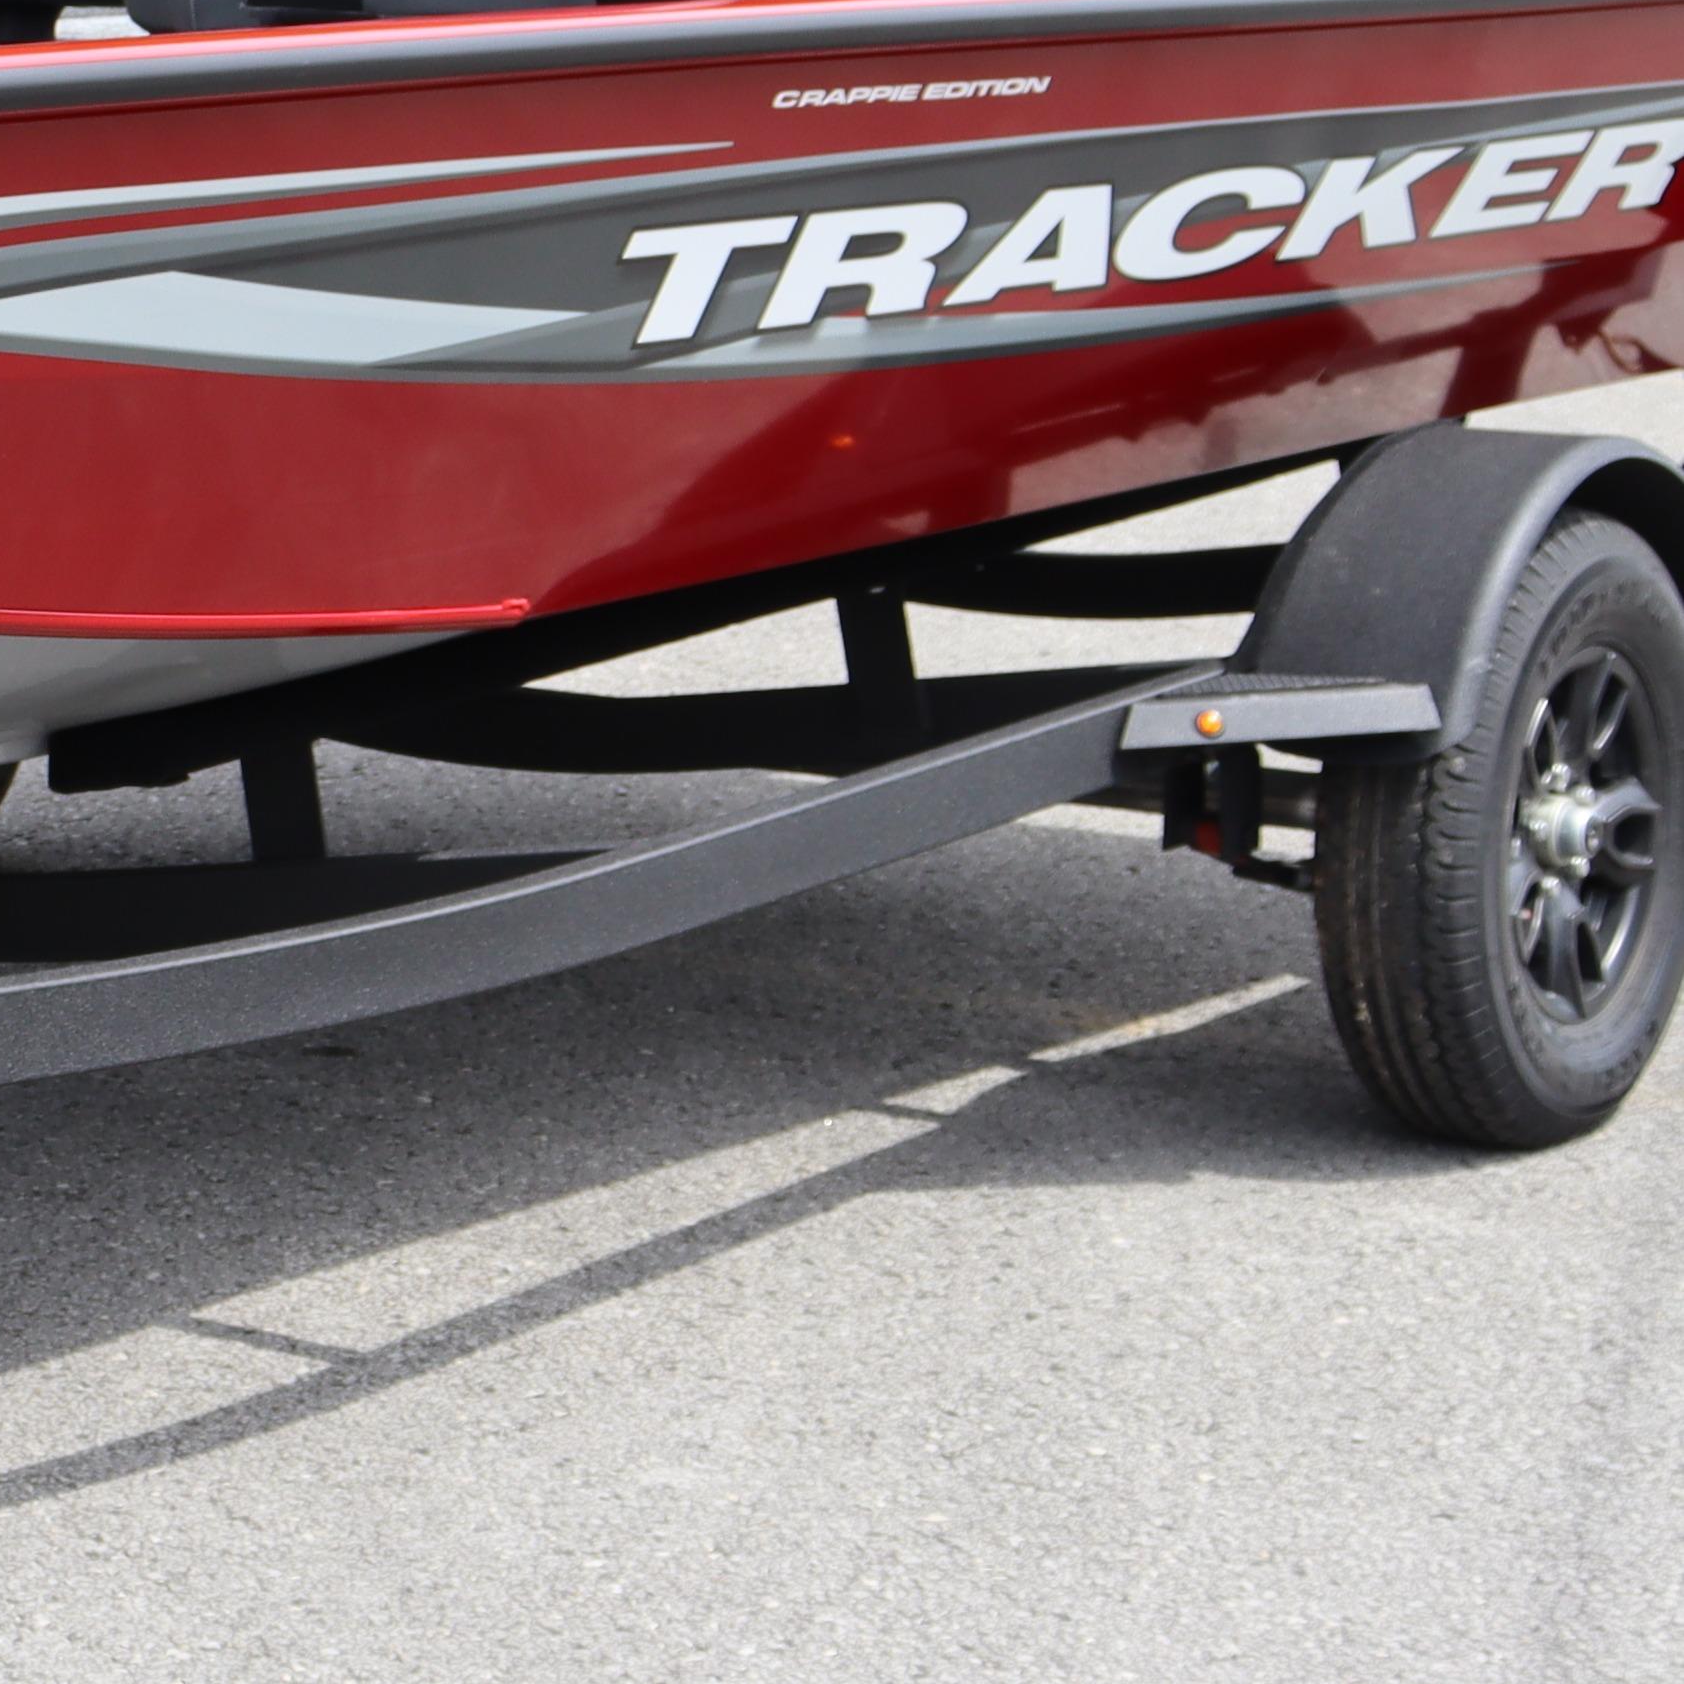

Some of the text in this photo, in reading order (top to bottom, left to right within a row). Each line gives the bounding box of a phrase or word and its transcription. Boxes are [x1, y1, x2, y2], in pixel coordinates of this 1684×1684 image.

[772, 76, 1052, 108] CRAPPIE EDITION
[620, 117, 1684, 349] TRACKER
